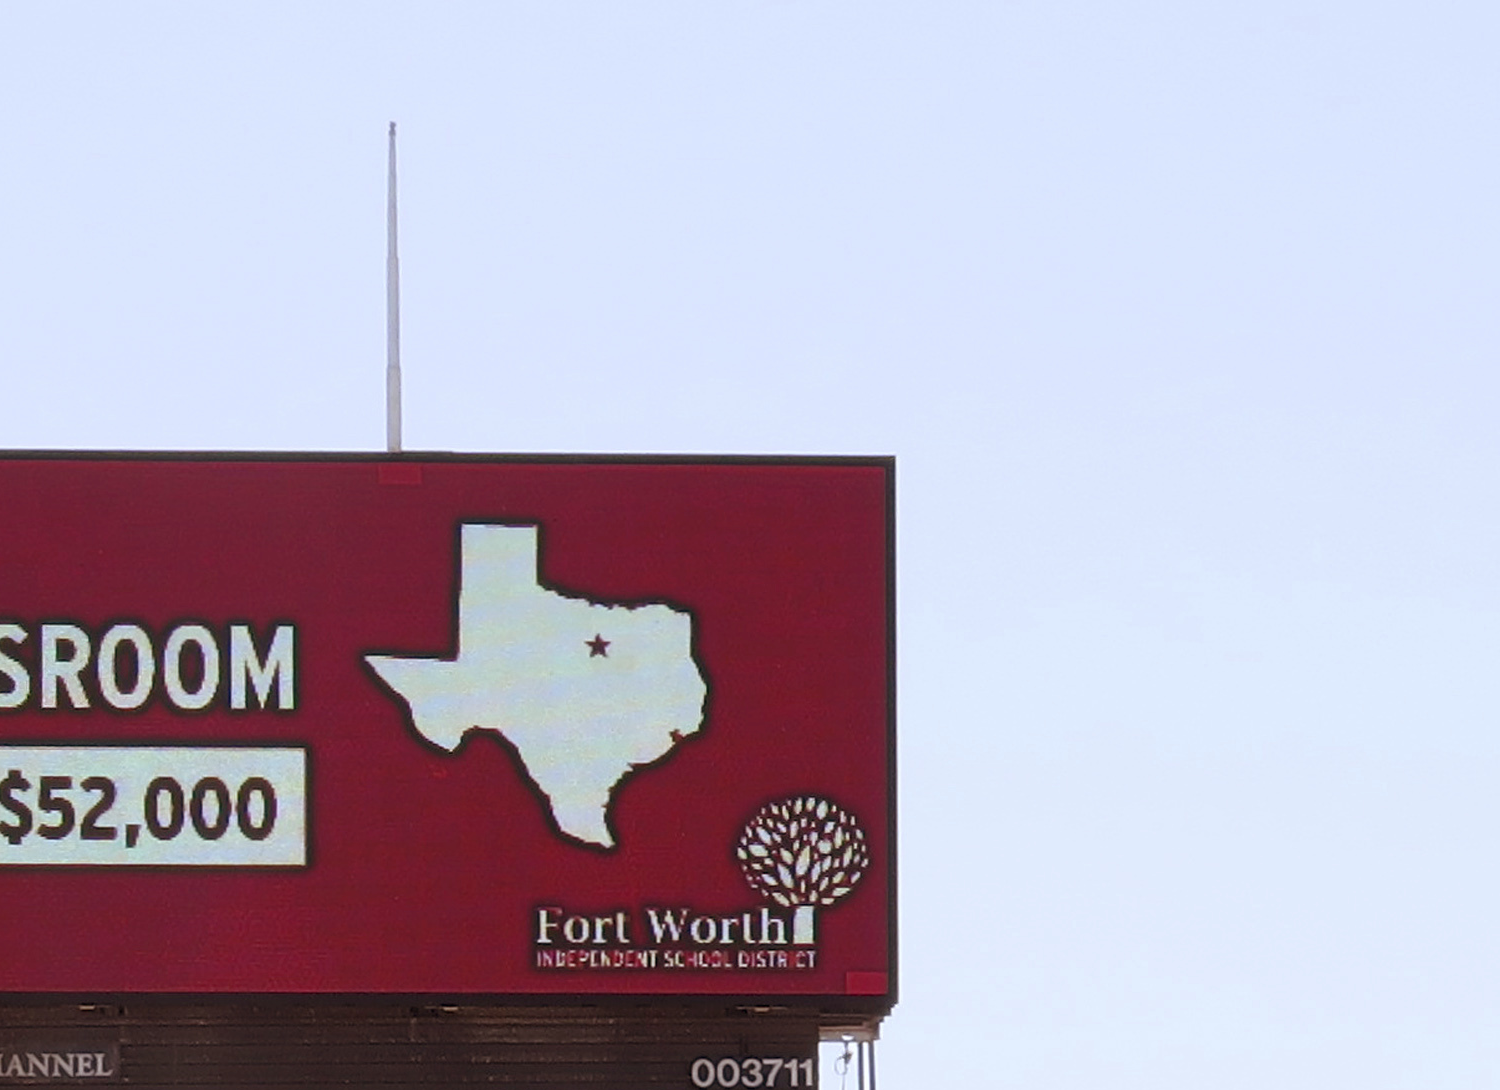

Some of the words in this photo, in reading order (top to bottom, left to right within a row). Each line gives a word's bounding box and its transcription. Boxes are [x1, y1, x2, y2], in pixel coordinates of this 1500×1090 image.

[537, 908, 630, 944] Fort
[646, 908, 787, 944] Worth
[536, 949, 658, 968] INDEPENDENT
[664, 949, 732, 968] SCHOOL
[738, 949, 815, 968] DISTRICT
[691, 1058, 813, 1088] 003711
